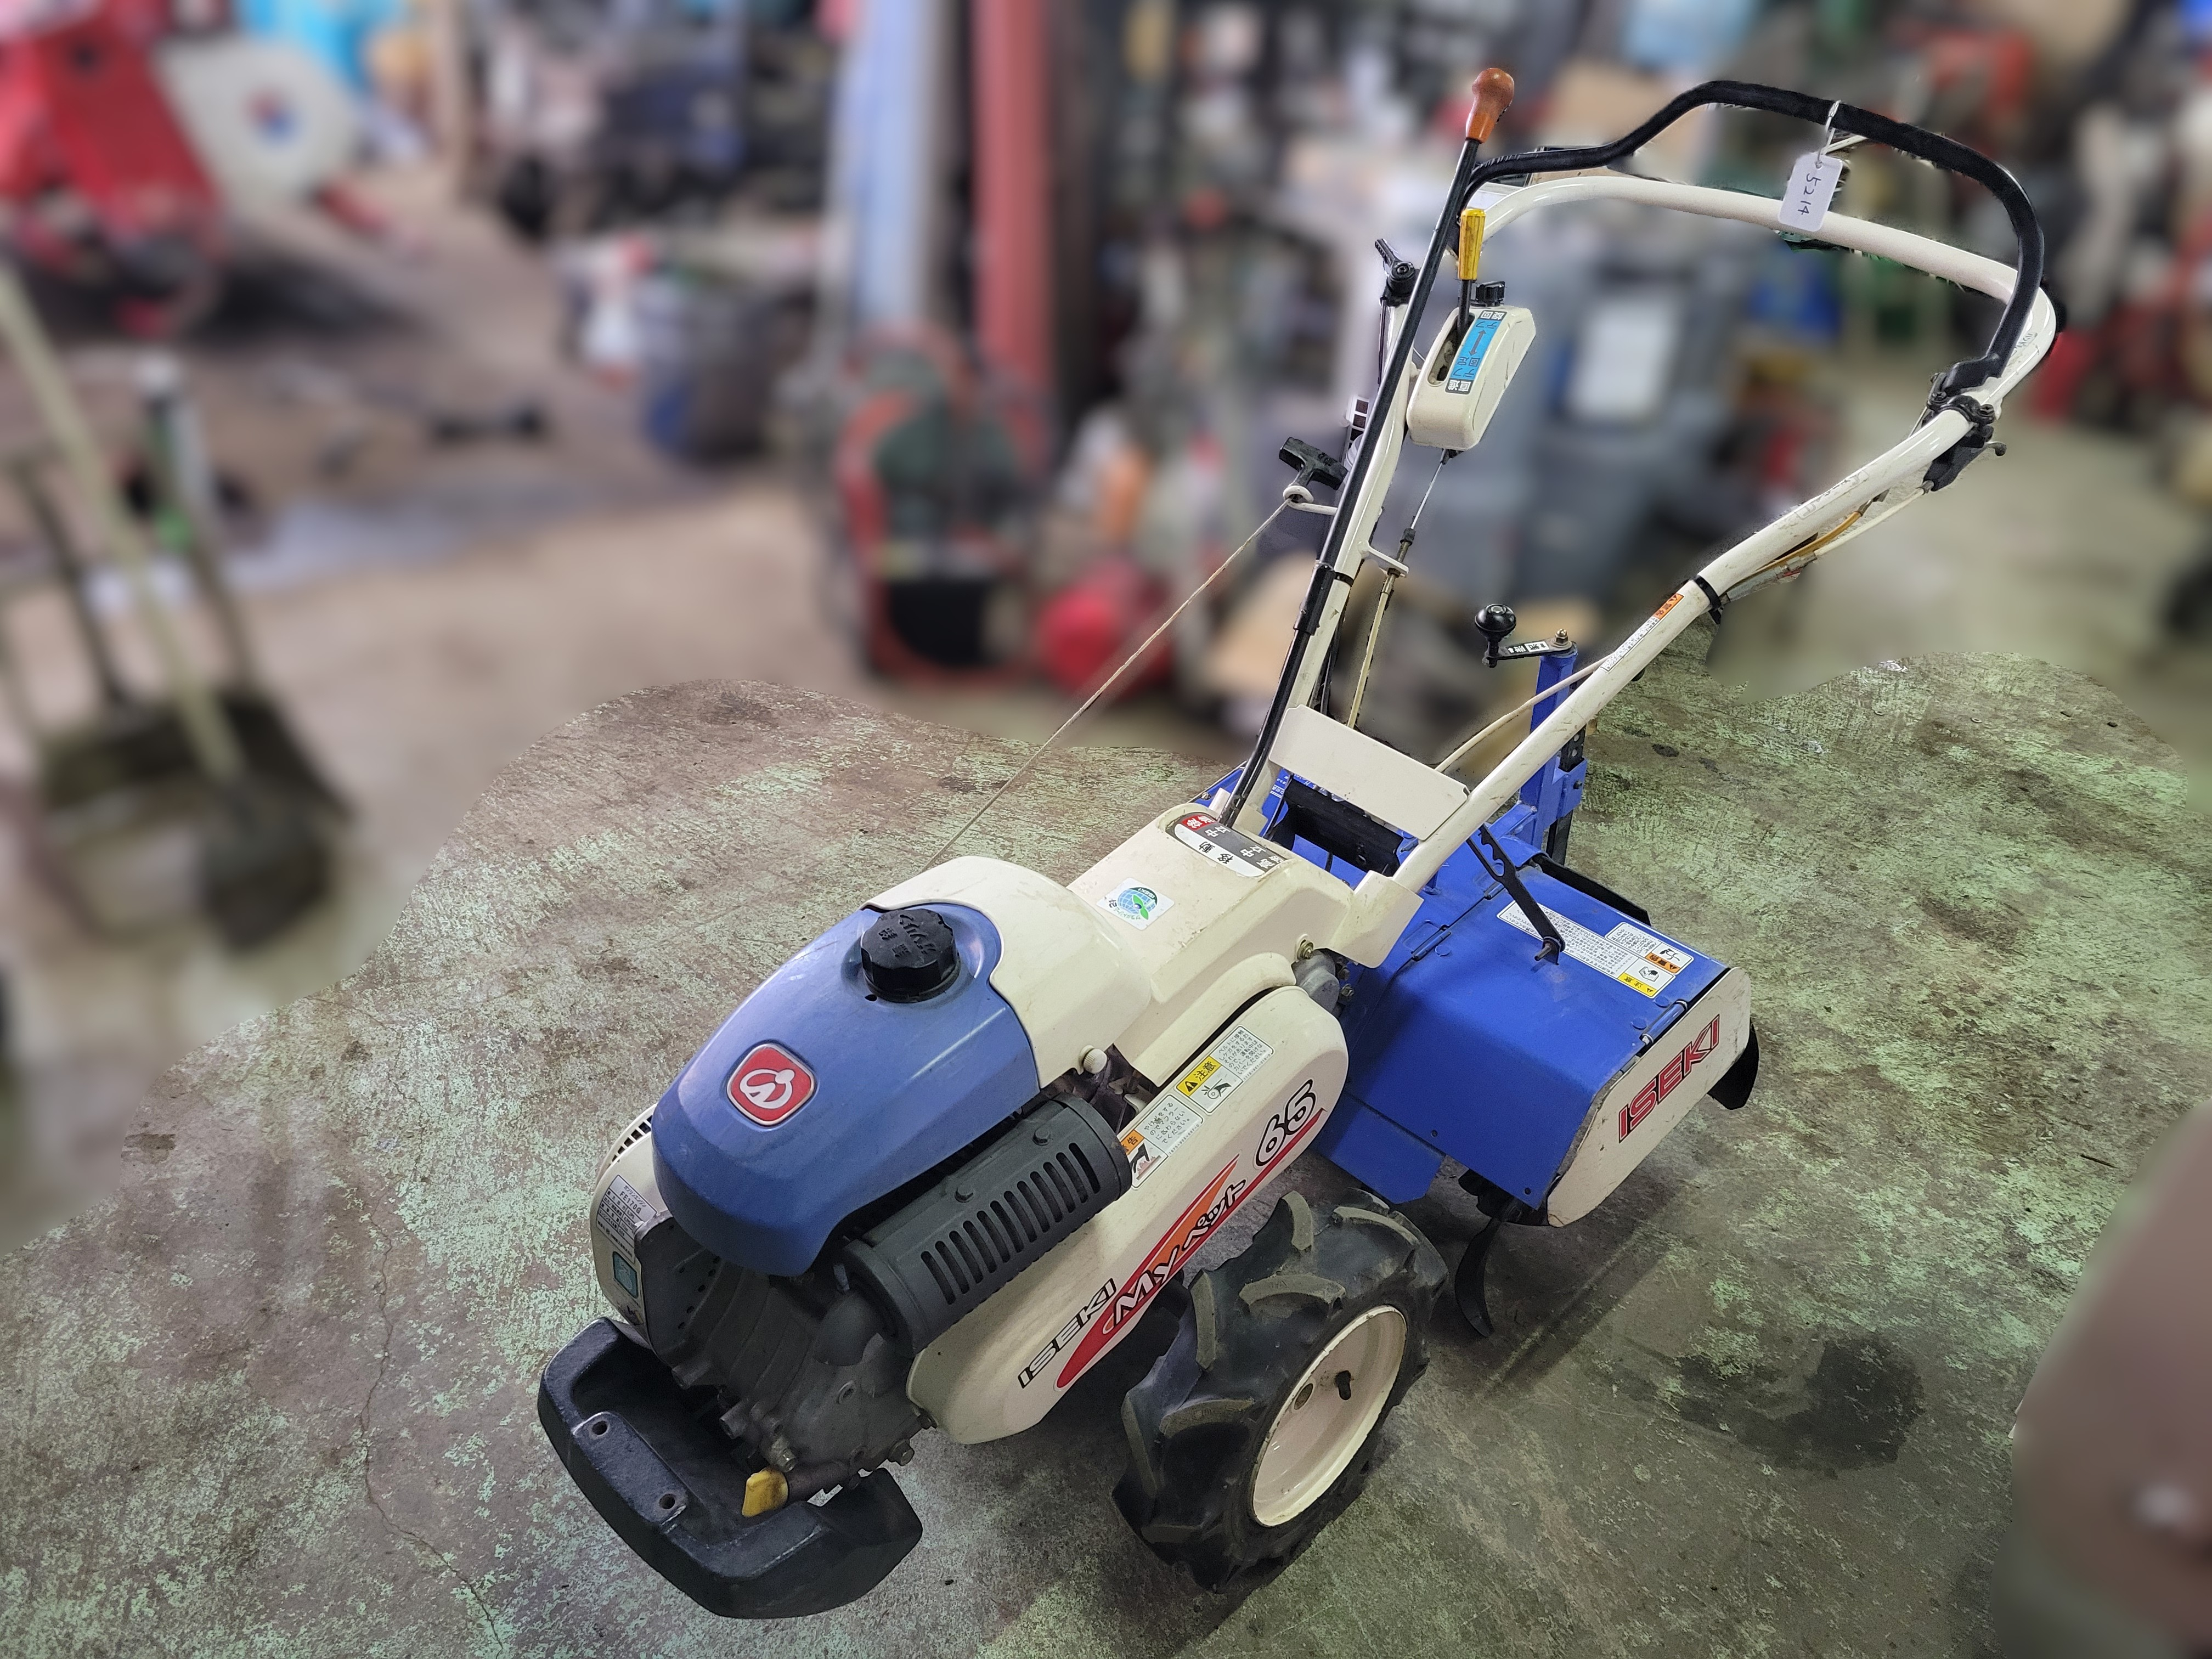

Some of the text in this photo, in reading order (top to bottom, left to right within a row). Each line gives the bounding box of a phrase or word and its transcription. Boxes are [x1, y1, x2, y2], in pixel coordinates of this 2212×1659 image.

[1798, 173, 1821, 215] 5214
[1480, 311, 1504, 320] 旋回
[1457, 357, 1480, 366] 固定
[1453, 368, 1475, 377] デフ
[1448, 380, 1471, 392] 直進
[1205, 825, 1232, 838] 中立
[1240, 845, 1266, 857] 中立
[1137, 888, 1155, 899] ISEKI
[1649, 954, 1667, 967] 警告
[1624, 976, 1643, 989] 注意
[1238, 1049, 1266, 1075] いでください。
[1194, 1061, 1216, 1081] 注意
[1618, 1014, 1720, 1144] ISEKI
[1255, 1079, 1317, 1167] 65
[1161, 1118, 1190, 1143] でください。
[619, 1191, 641, 1214] FE170G
[1017, 1278, 1117, 1389] ISEKI
